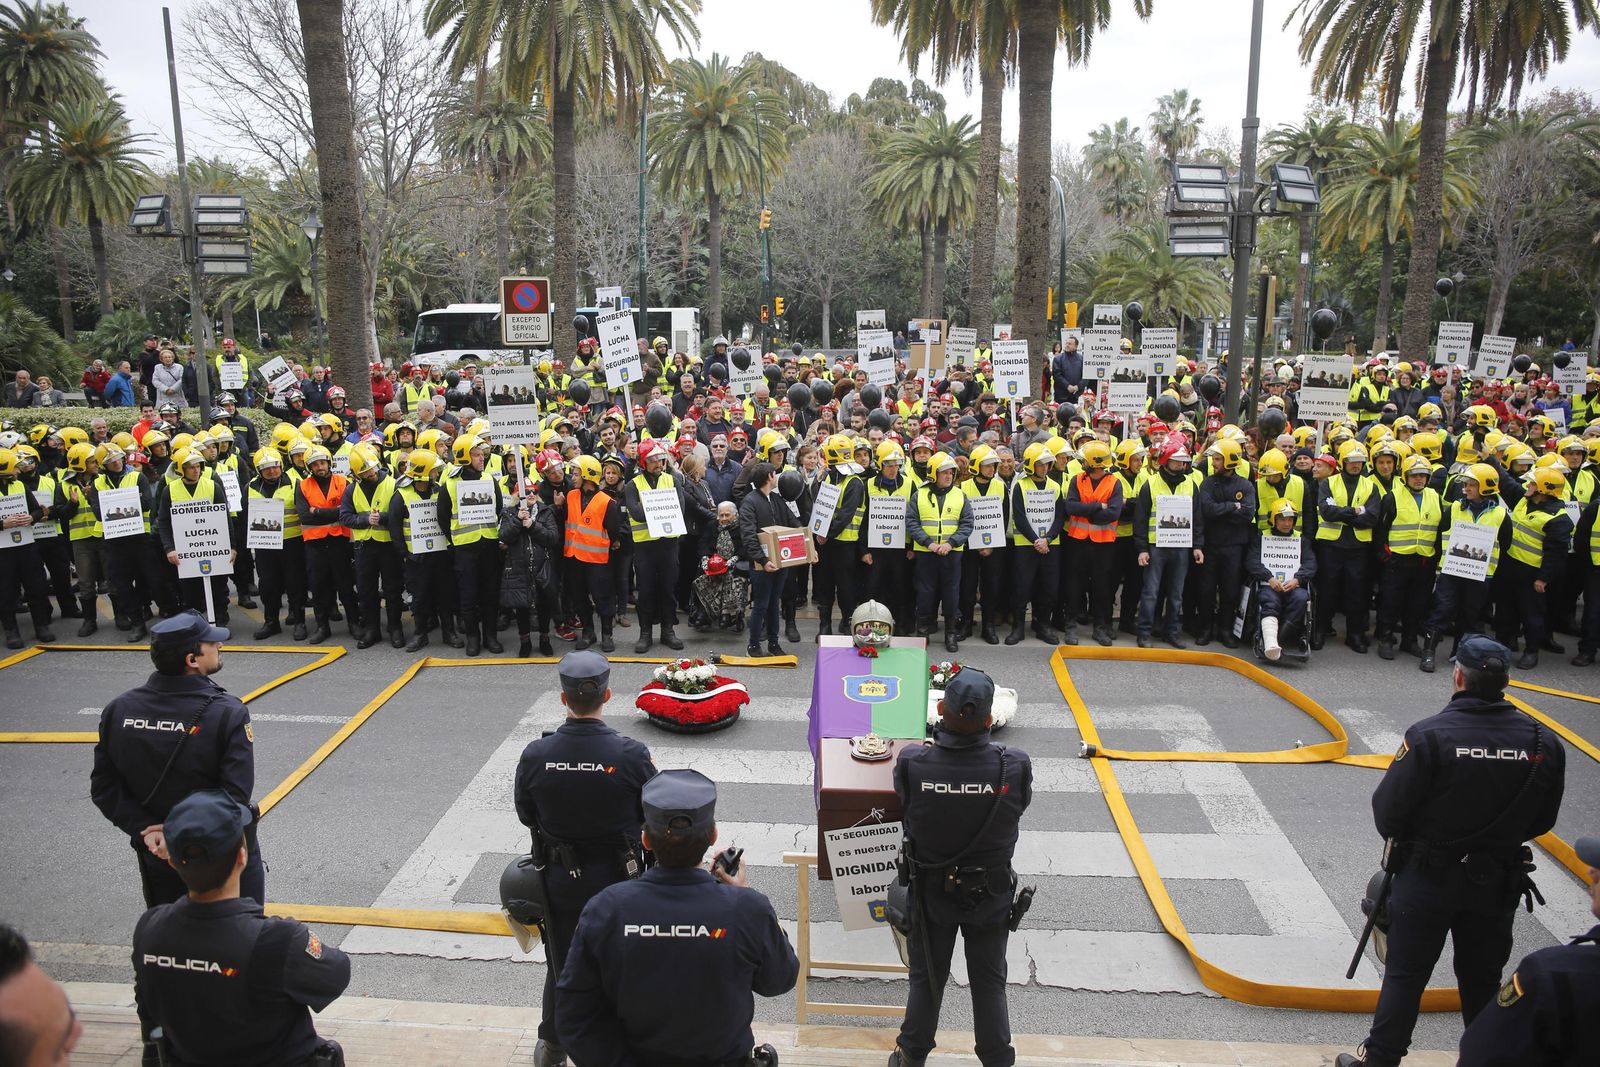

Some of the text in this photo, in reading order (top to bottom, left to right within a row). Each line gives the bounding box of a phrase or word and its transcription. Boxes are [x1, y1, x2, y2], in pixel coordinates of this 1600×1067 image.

[596, 309, 632, 324] BOMBEROS
[608, 334, 630, 346] LUCHA
[1480, 348, 1512, 356] DIGNIDAD
[606, 354, 639, 370] SEGURIDAD
[171, 504, 226, 515] BOMBEROS
[816, 499, 834, 510] DIGNIDAD
[185, 528, 219, 537] LUCHA
[413, 531, 445, 539] SEGURIDAD
[178, 549, 230, 560] SEGURIDAD
[122, 718, 186, 732] POLICIA
[1455, 748, 1529, 761] POLICIA
[545, 762, 606, 772] POLICIA
[921, 782, 995, 794] POLICIA
[828, 826, 899, 842] Tu SEGURIDAD
[838, 843, 897, 857] es nuestra
[835, 860, 896, 878] DIGNIDA
[851, 884, 890, 896] labor
[624, 924, 711, 937] POLICIA
[143, 954, 222, 974] POLICIA
